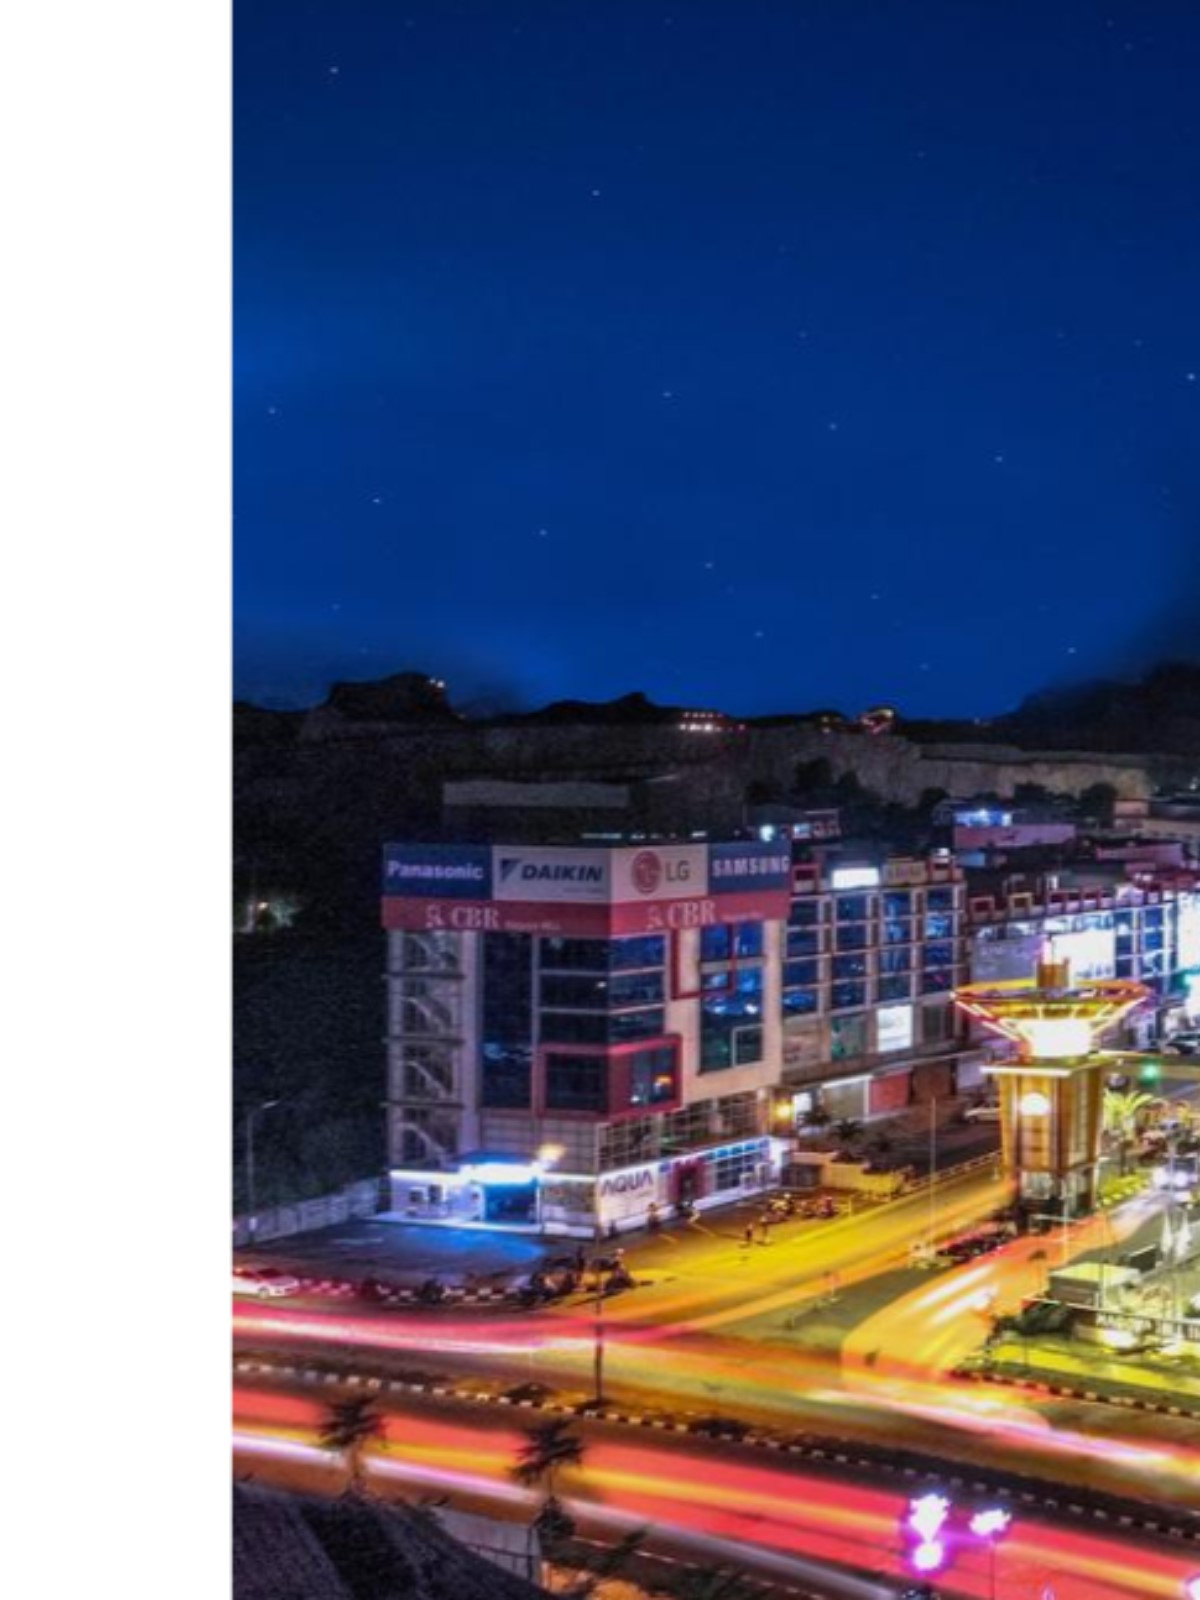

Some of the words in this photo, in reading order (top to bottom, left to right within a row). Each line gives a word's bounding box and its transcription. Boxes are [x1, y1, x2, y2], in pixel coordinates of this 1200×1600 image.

[387, 860, 484, 880] Panasonic
[521, 864, 603, 882] DAIKIN
[665, 860, 691, 882] LG
[712, 855, 790, 877] SAMSUNG
[452, 905, 498, 929] CBR
[667, 899, 716, 929] CBR
[602, 1169, 653, 1194] AQUA
